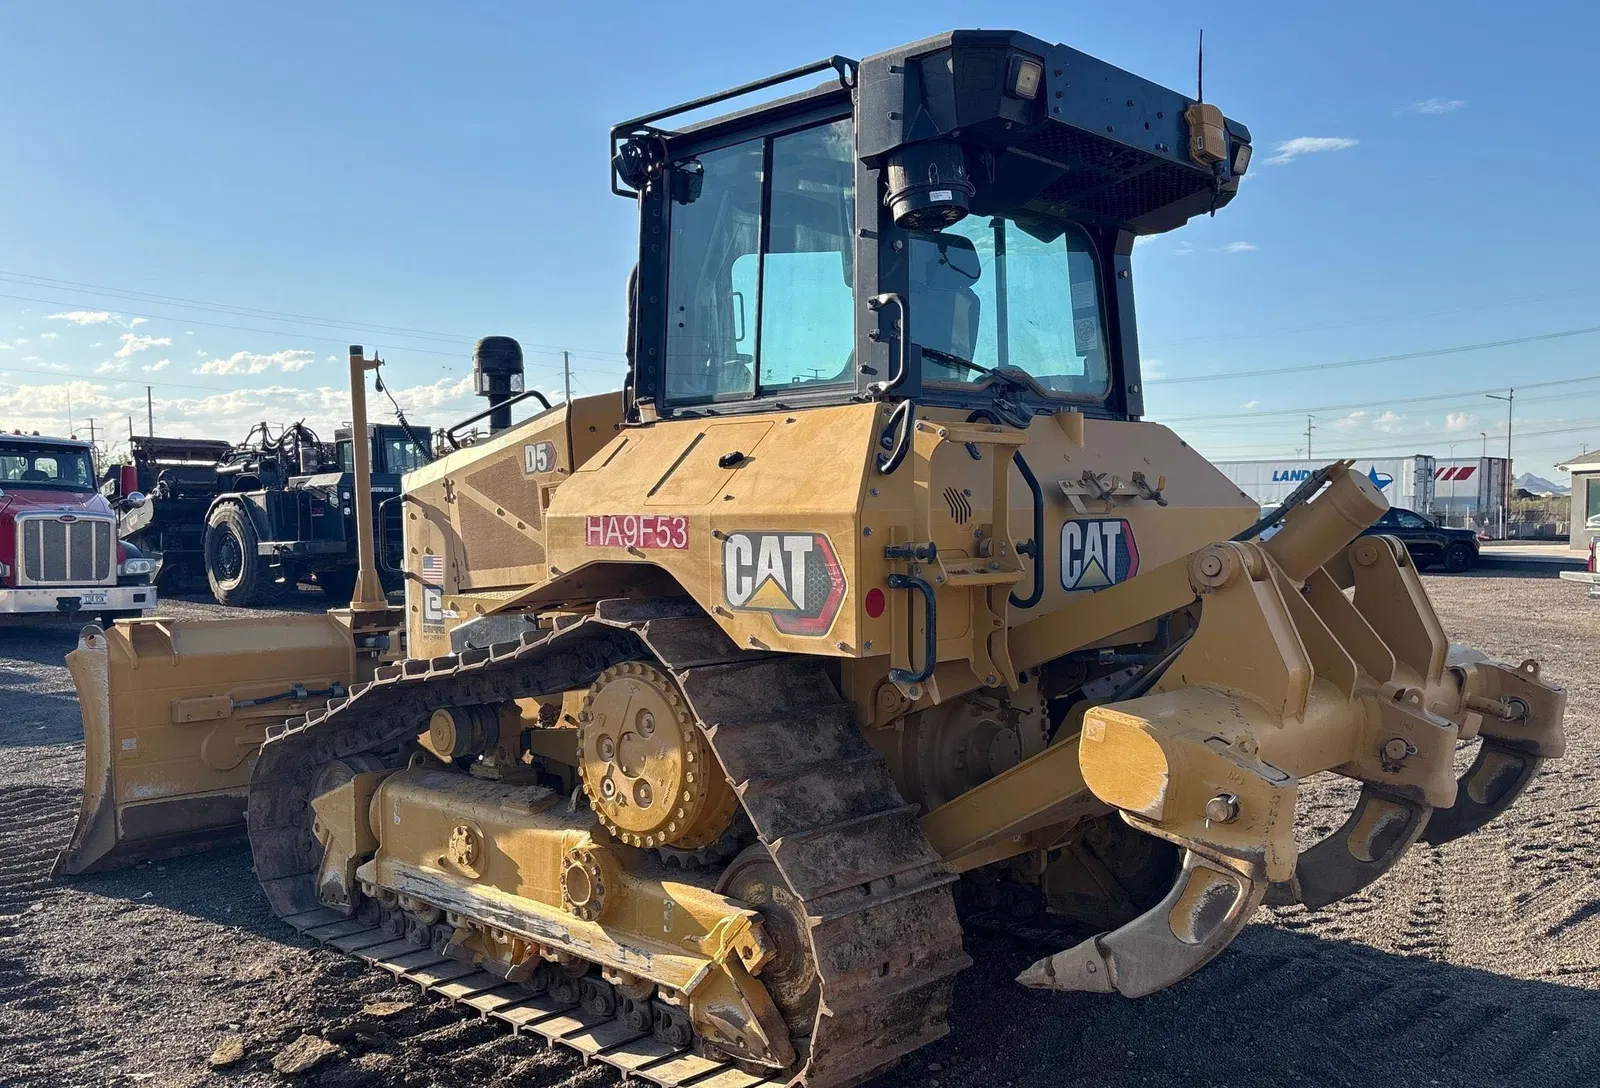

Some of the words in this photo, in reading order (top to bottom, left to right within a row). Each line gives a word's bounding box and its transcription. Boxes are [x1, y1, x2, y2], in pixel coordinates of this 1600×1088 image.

[524, 443, 548, 473] D5
[1272, 470, 1312, 482] LAND
[586, 515, 688, 548] HA9F53
[1061, 521, 1121, 589] CAT
[725, 534, 813, 611] CAT
